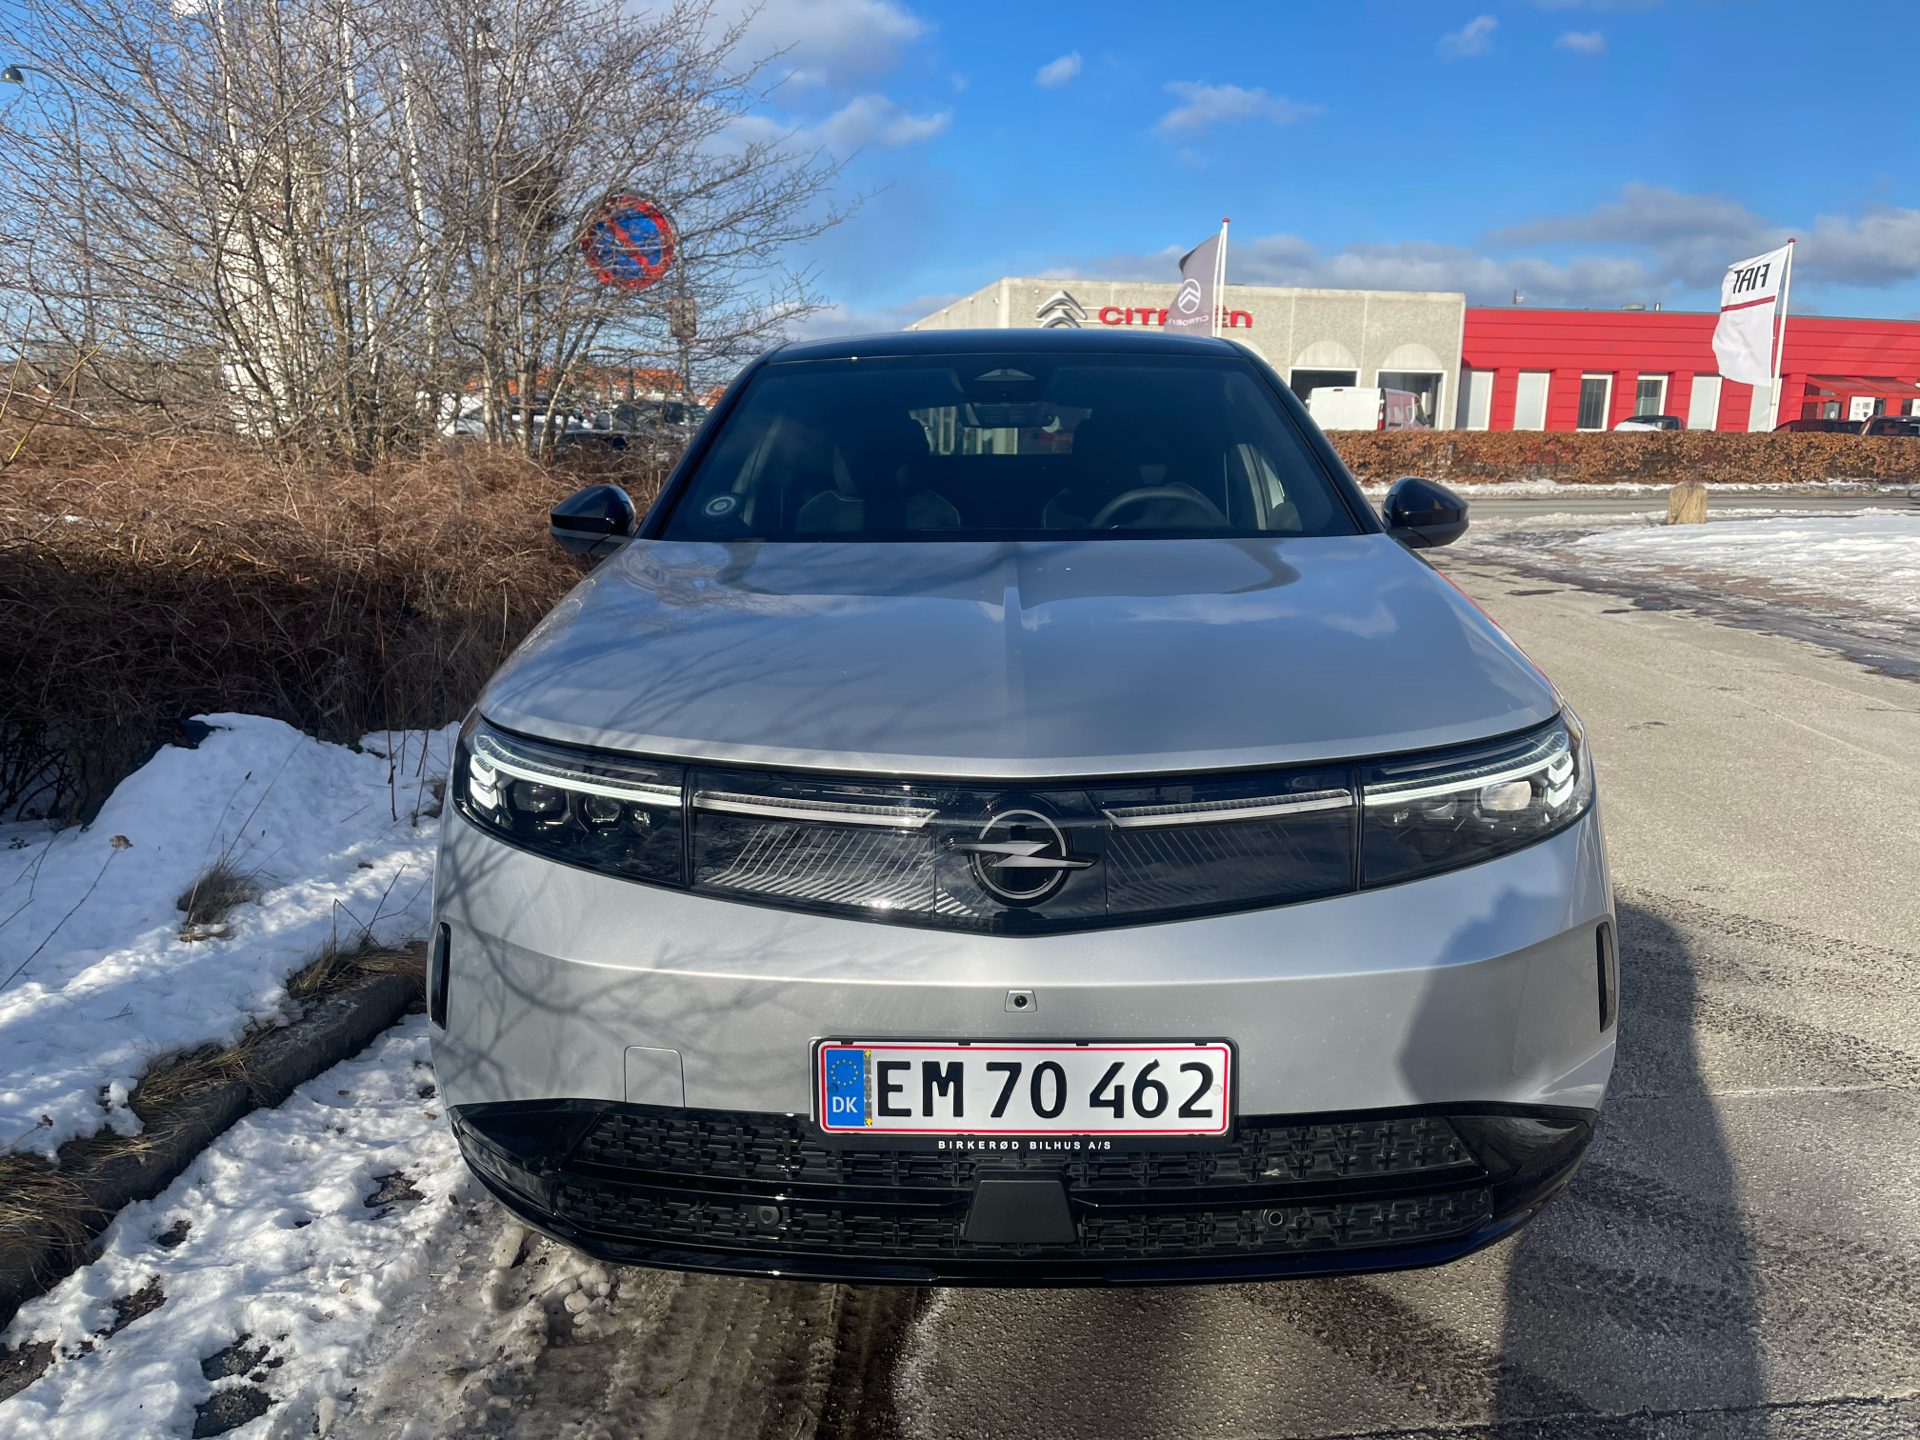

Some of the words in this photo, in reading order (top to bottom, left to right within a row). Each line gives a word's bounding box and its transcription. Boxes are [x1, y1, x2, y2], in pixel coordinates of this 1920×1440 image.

[876, 1060, 964, 1118] EM
[986, 1059, 1068, 1119] 70
[1089, 1058, 1214, 1119] 462
[832, 1096, 858, 1113] DK
[938, 1140, 1020, 1150] BIRKERØD
[1029, 1140, 1081, 1150] BILHUS
[1088, 1141, 1112, 1150] A/S
